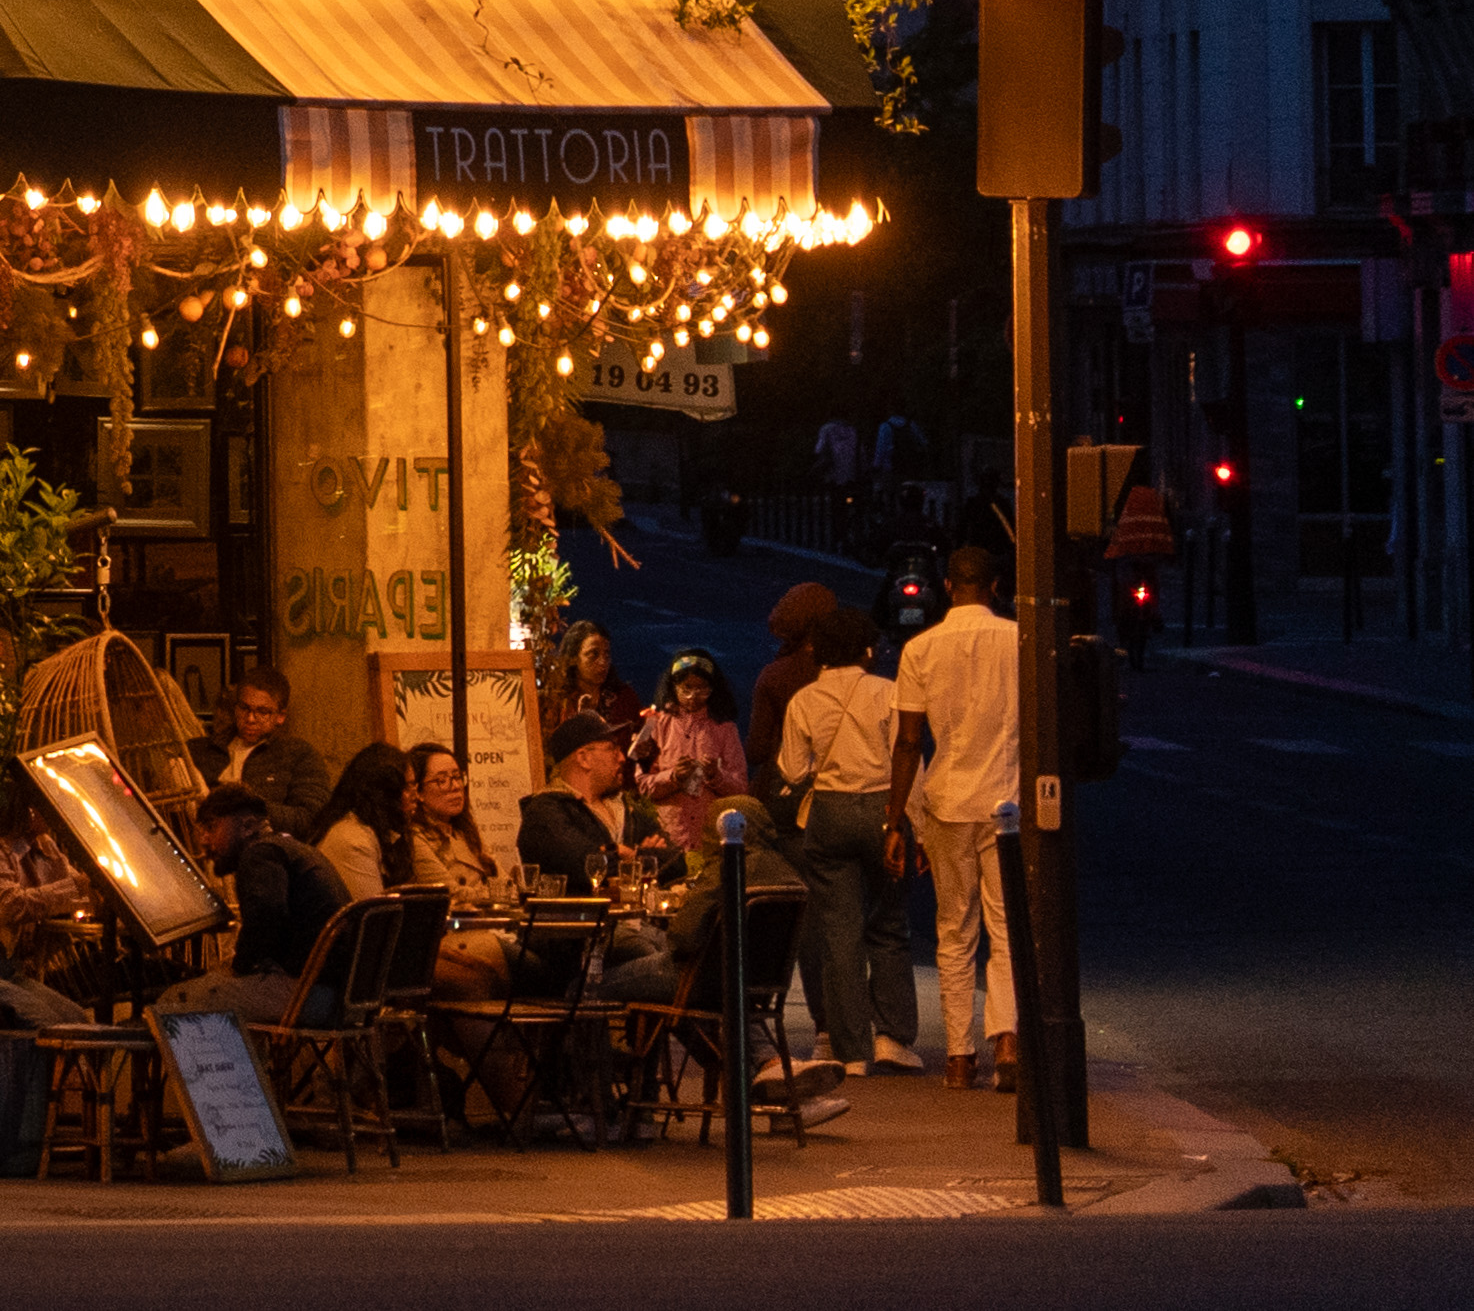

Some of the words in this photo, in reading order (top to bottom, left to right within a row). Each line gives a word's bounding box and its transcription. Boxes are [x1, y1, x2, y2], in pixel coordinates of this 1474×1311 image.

[426, 126, 672, 184] TRATTORIA
[593, 363, 625, 388] 19
[636, 370, 672, 393] 04
[683, 372, 719, 397] 93
[474, 751, 504, 764] OPEN
